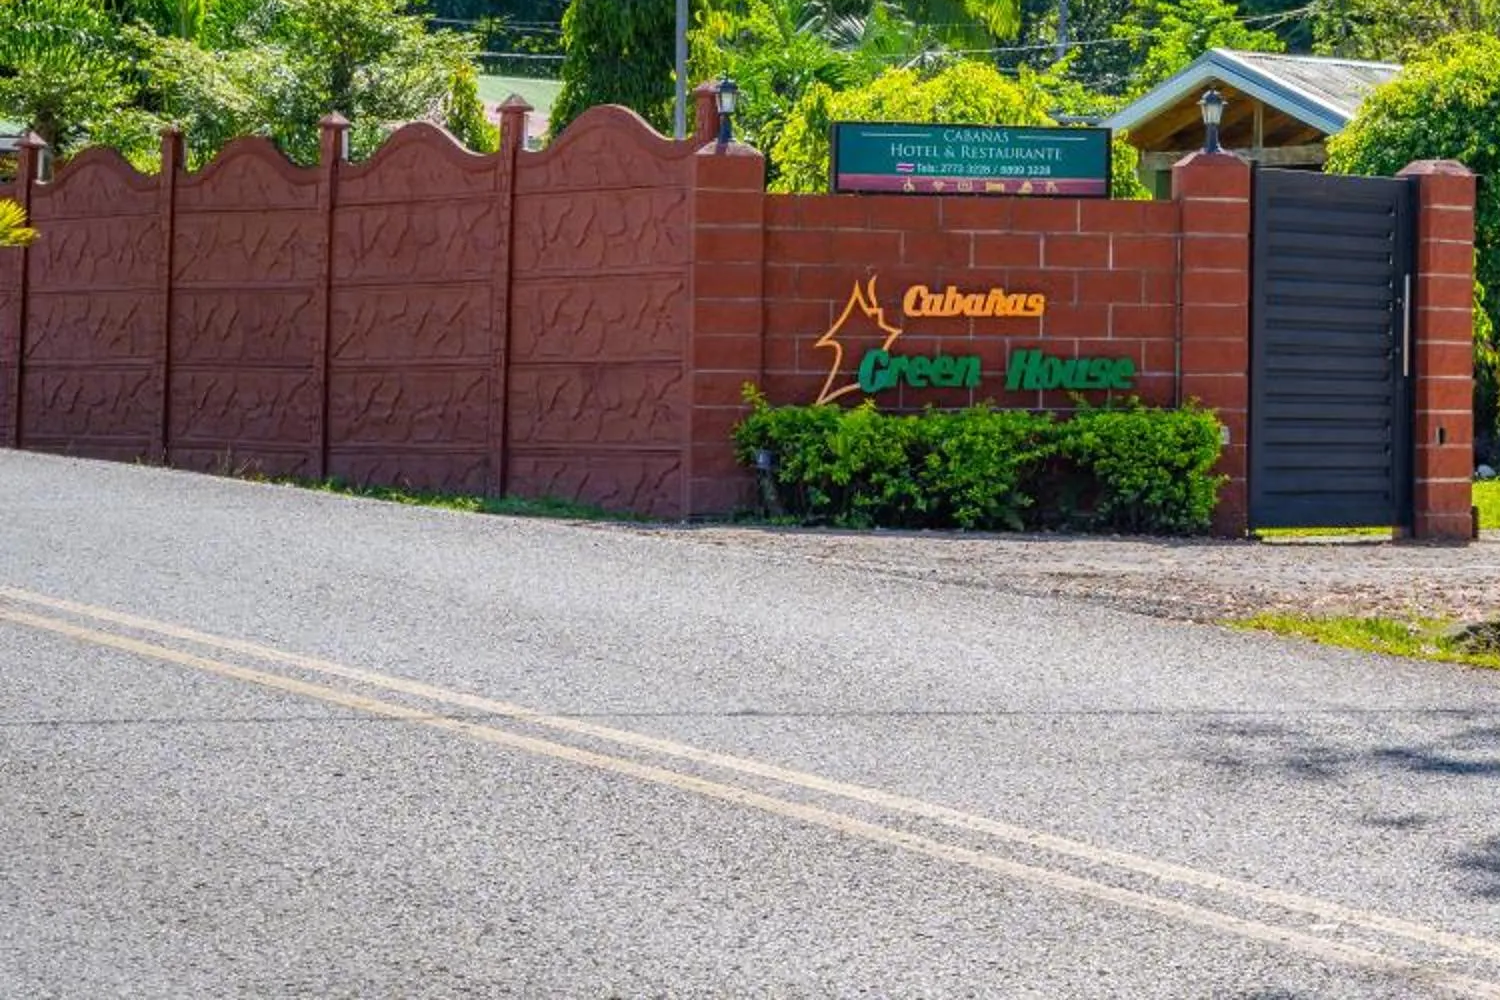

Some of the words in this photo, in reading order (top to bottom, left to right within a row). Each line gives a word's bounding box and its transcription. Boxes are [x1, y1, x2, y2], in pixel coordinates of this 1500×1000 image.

[891, 143, 941, 158] HOTEL
[945, 145, 956, 158] &
[961, 145, 1062, 161] RESTAURANTE
[903, 285, 1045, 317] Cabañas
[857, 348, 982, 393] Green
[1005, 348, 1137, 390] House
